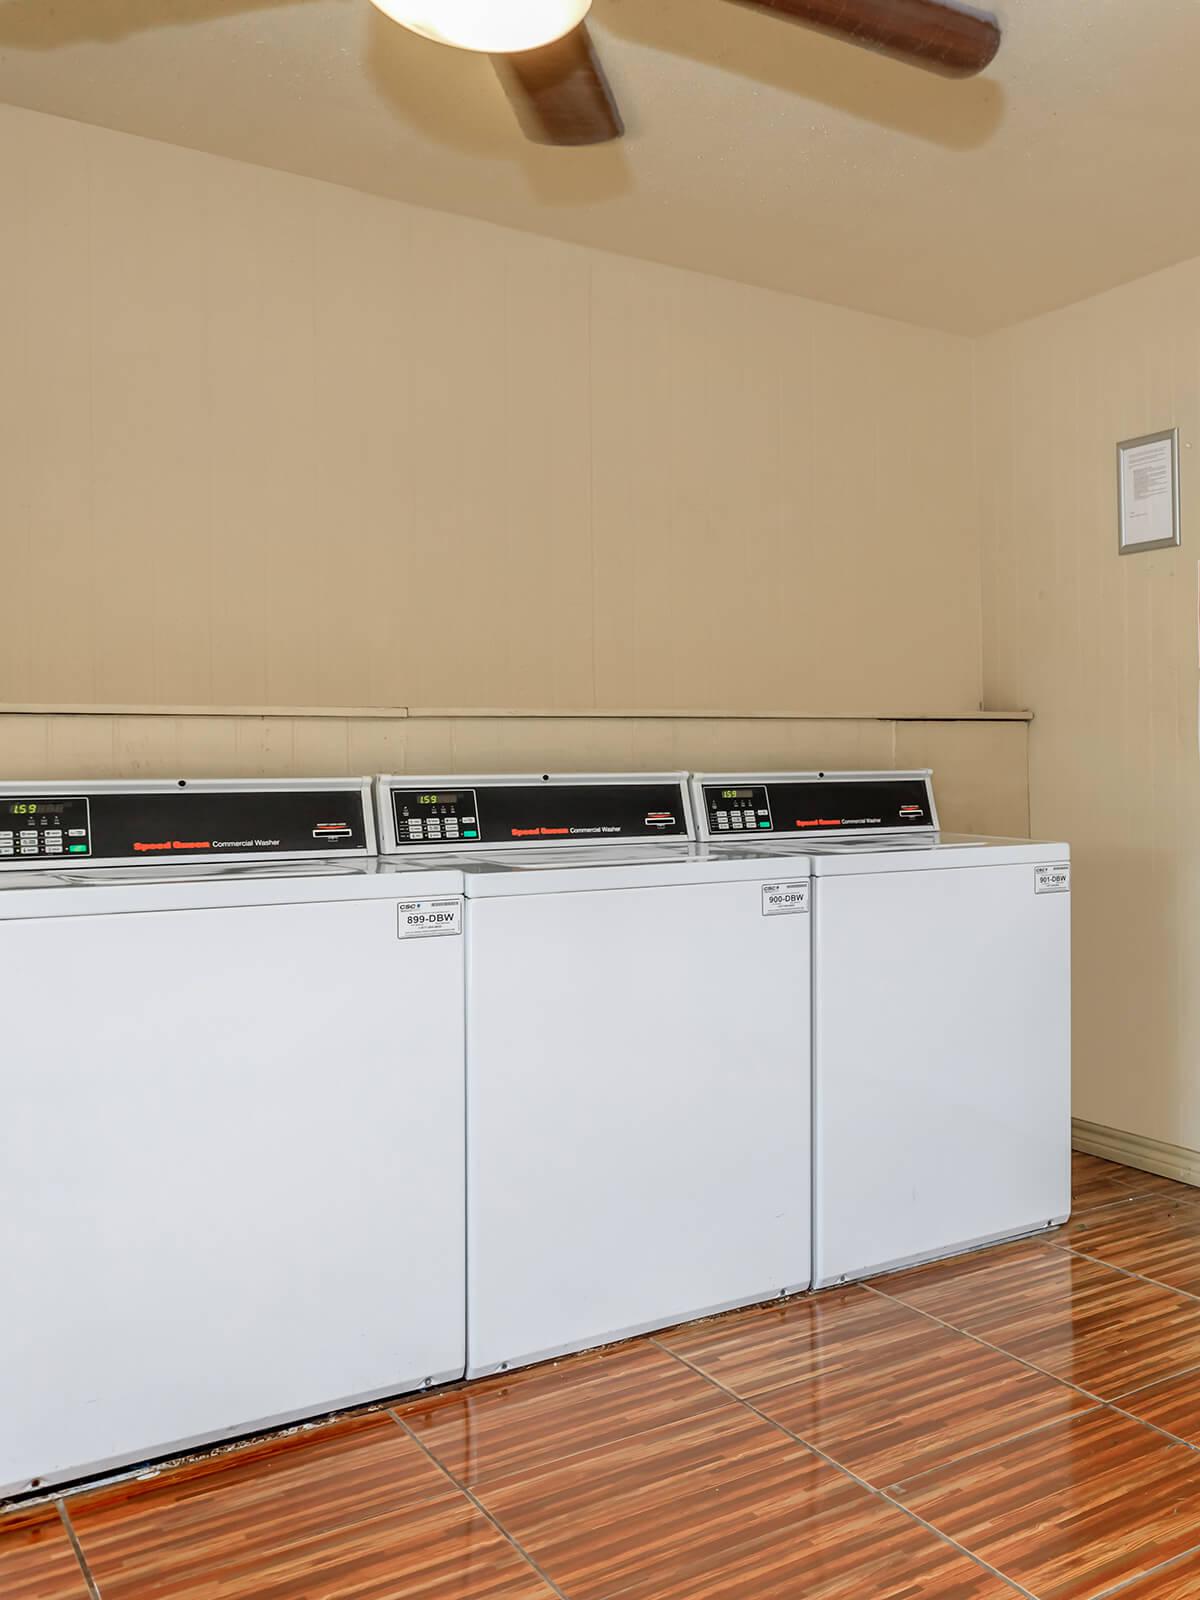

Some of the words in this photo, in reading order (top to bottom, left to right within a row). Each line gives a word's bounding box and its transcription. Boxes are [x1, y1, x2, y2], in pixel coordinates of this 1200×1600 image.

[212, 840, 254, 848] Commercial
[255, 839, 280, 847] Washer
[768, 894, 804, 904] 900-DBW
[407, 913, 455, 925] 899-DBW
